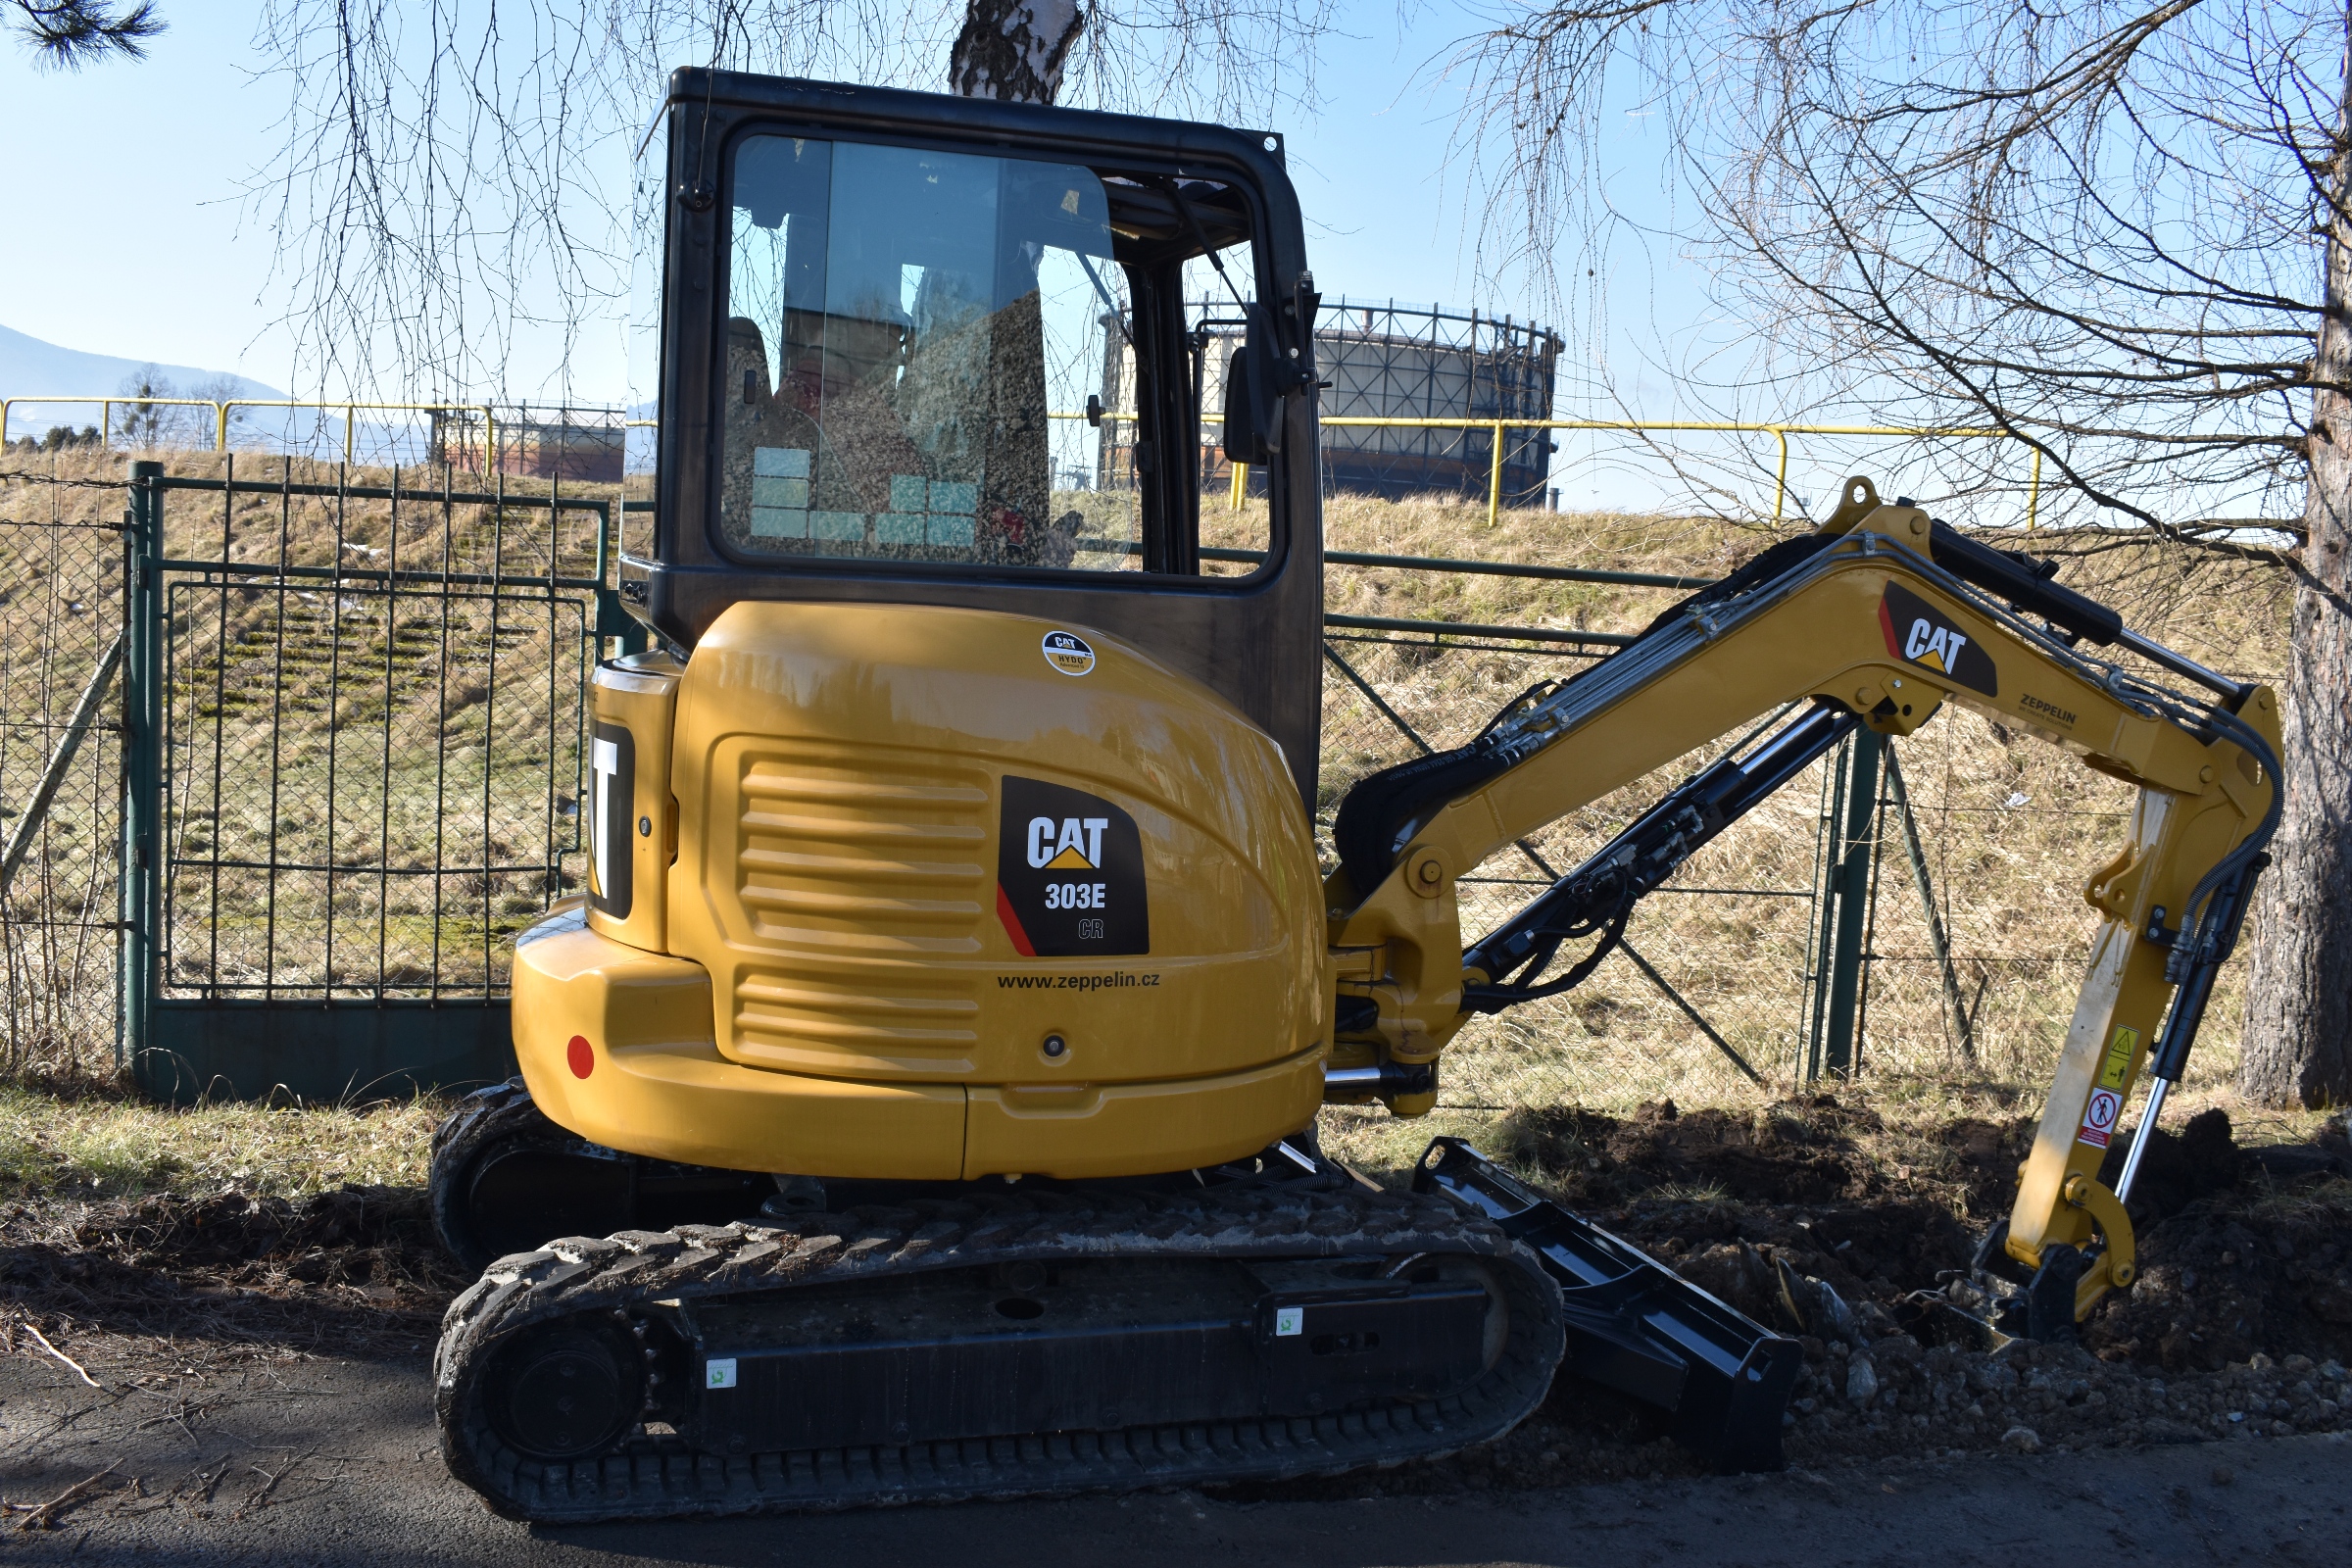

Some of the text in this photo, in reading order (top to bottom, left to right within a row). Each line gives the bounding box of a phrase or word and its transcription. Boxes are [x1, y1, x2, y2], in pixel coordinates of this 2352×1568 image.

[1054, 636, 1076, 649] CAT
[1905, 617, 1967, 674] CAT
[2020, 693, 2077, 724] ZEPPELIN
[1454, 745, 1477, 760] CAT
[1027, 816, 1108, 869] CAT
[1045, 883, 1106, 909] 303E
[1077, 918, 1104, 940] CR
[998, 970, 1160, 992] www.zeppelin.cz
